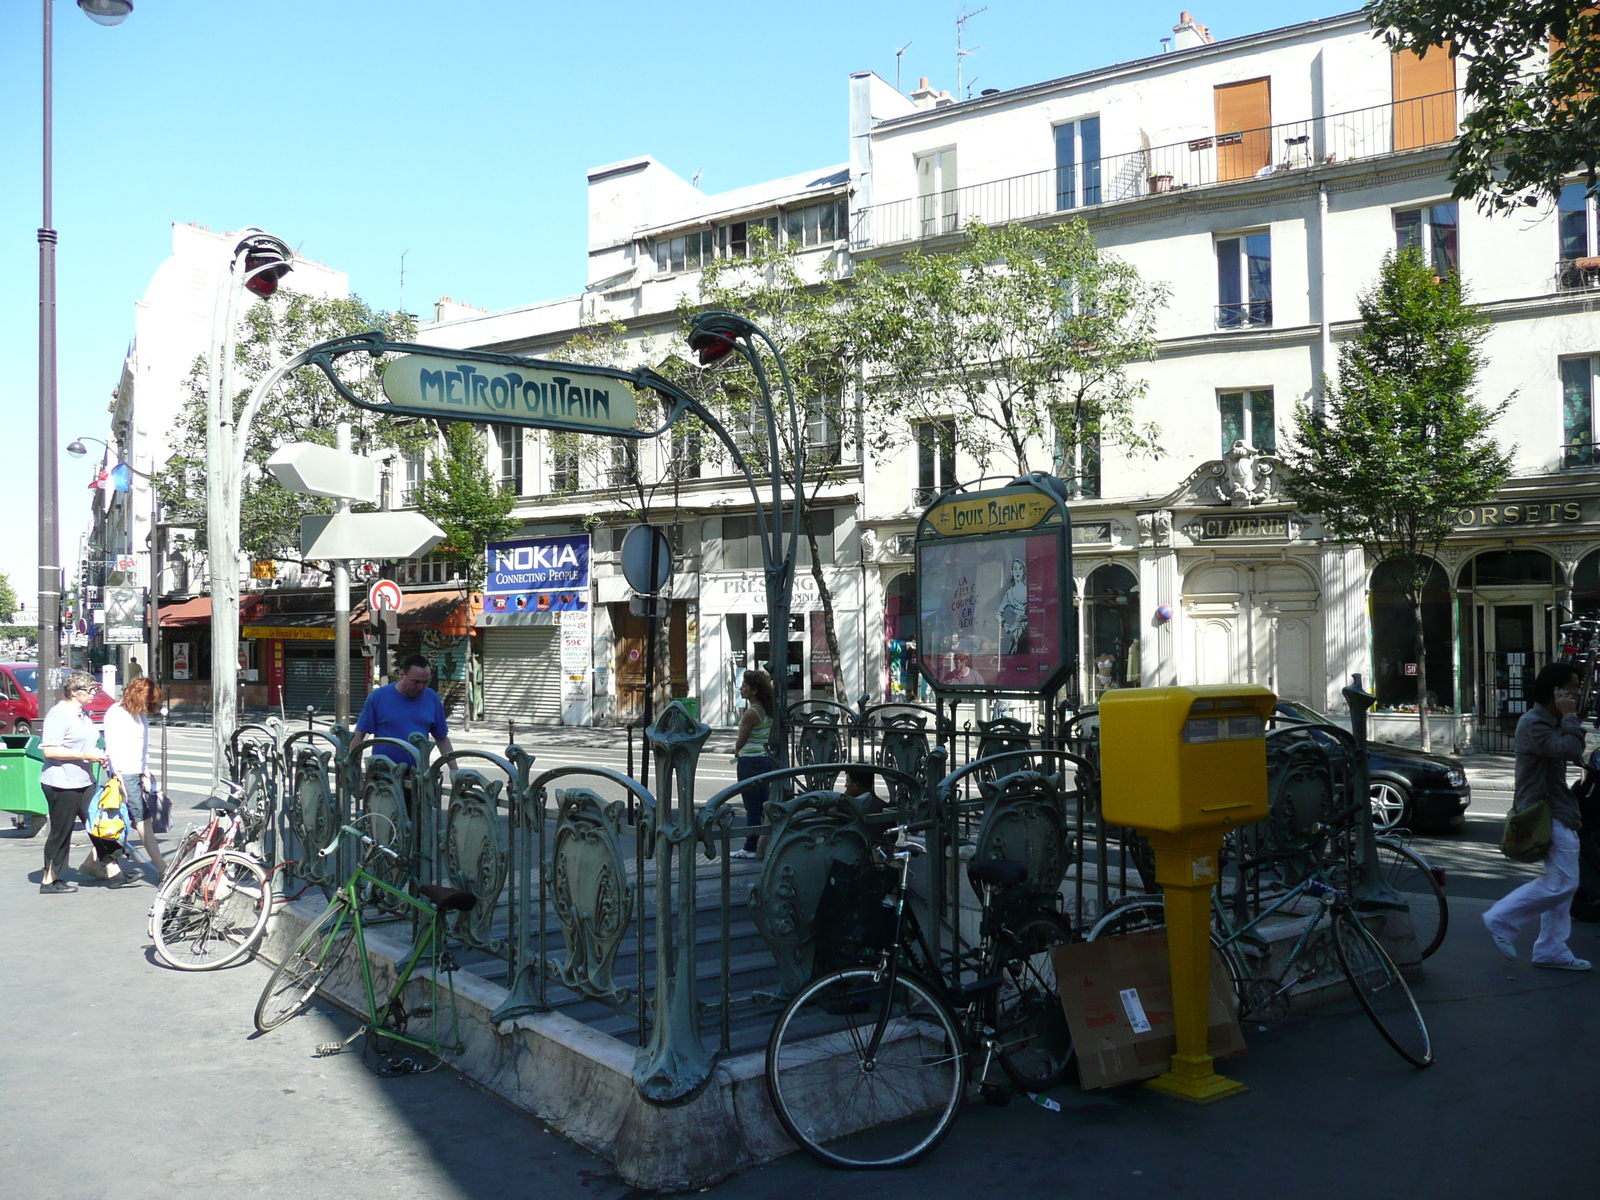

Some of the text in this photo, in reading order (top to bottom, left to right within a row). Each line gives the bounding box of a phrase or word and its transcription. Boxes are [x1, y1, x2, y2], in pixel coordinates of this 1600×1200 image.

[419, 364, 611, 420] METROPOLITAIN
[952, 500, 1026, 531] LOUIS BLANC
[1448, 502, 1582, 527] ORSETS
[1206, 518, 1286, 537] CLAVERIE
[495, 544, 579, 572] NOKIA
[496, 569, 579, 585] CONNECTING PEOPLE
[723, 577, 814, 594] PRESNG
